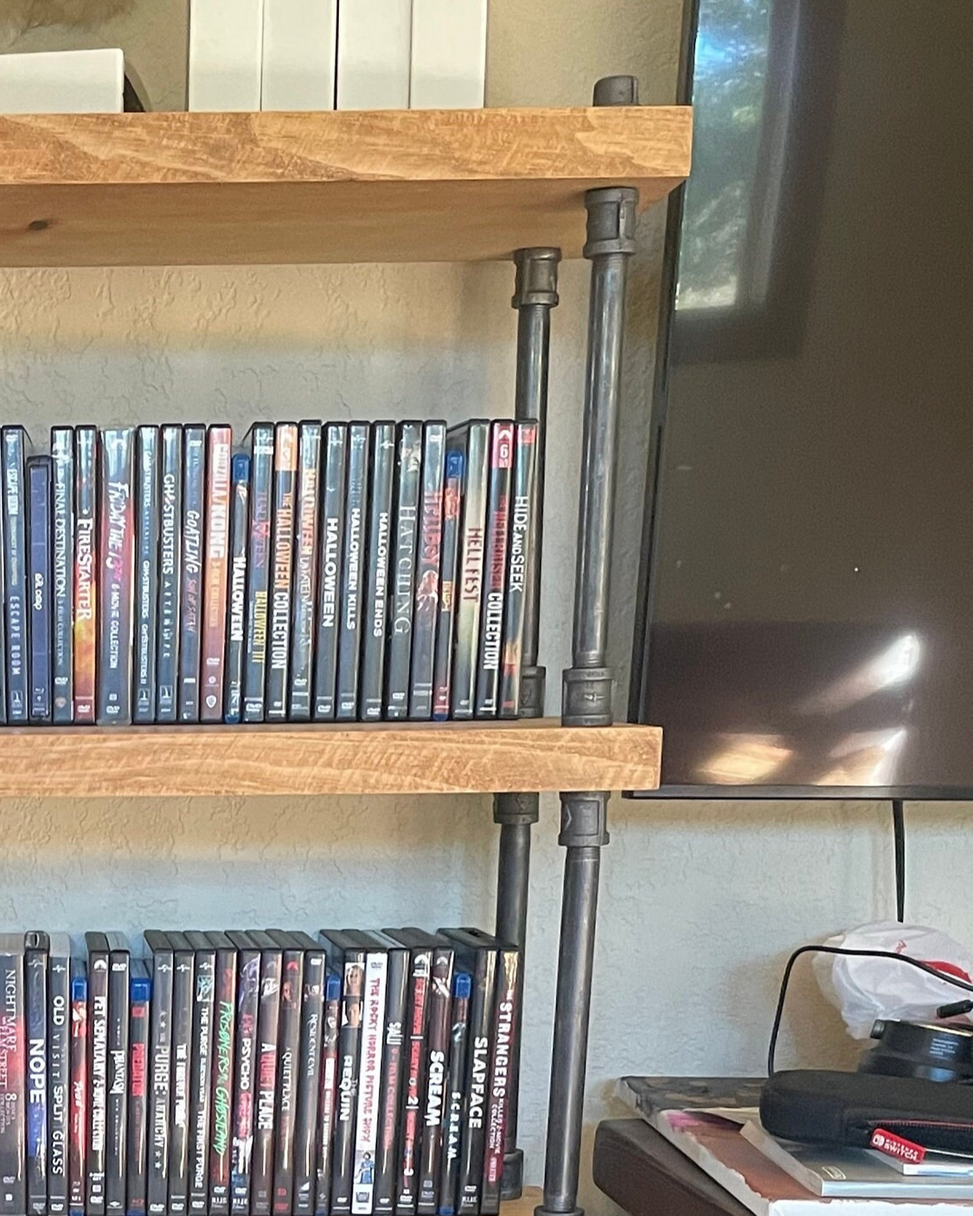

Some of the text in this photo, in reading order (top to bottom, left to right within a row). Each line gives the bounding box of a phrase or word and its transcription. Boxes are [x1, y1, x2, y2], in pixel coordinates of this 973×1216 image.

[55, 484, 66, 597] FINAL DESTINATION
[275, 508, 292, 589] HALLOWEEN
[322, 518, 338, 627] HALLOWEEN
[347, 508, 360, 629] HALLOWEEN KILLS
[374, 513, 388, 637] HALLOWEEN ENDS
[394, 505, 415, 636] HATCHING
[464, 528, 483, 602] HELL FEST
[510, 496, 529, 593] HIDE AND SEEK
[11, 596, 20, 675] ESCAPE ROOM
[231, 557, 245, 640] HALLOWEEN
[272, 592, 287, 669] COLLECTION
[484, 592, 503, 670] COLLECTION
[110, 620, 119, 668] COLLECTION
[52, 996, 64, 1025] OLD
[94, 996, 105, 1076] PET SEMATARY
[199, 1026, 208, 1056] PURGE
[363, 978, 380, 1114] THE ROCKY HORROR PICTURE
[387, 1022, 403, 1045] SAW
[0, 1050, 7, 1087] STREET
[29, 1039, 45, 1103] NOPE
[110, 1050, 124, 1094] PHANTASM
[132, 1043, 144, 1096] PREDATOR
[240, 1038, 252, 1089] PSYCHO
[259, 1043, 276, 1129] A QUIET PLACE
[282, 1052, 292, 1111] QUIET PLACE
[339, 1055, 352, 1120] REQUIN
[469, 1037, 487, 1128] SLAPFACE
[493, 1002, 512, 1097] STRANGERS
[53, 1085, 64, 1122] SPLIT
[155, 1098, 166, 1147] ANARCHY
[424, 1051, 444, 1126] SCREAM
[447, 1092, 460, 1159] SCREAM
[52, 1131, 63, 1174] GLASS
[195, 1110, 206, 1188] THE FIRST PURGE
